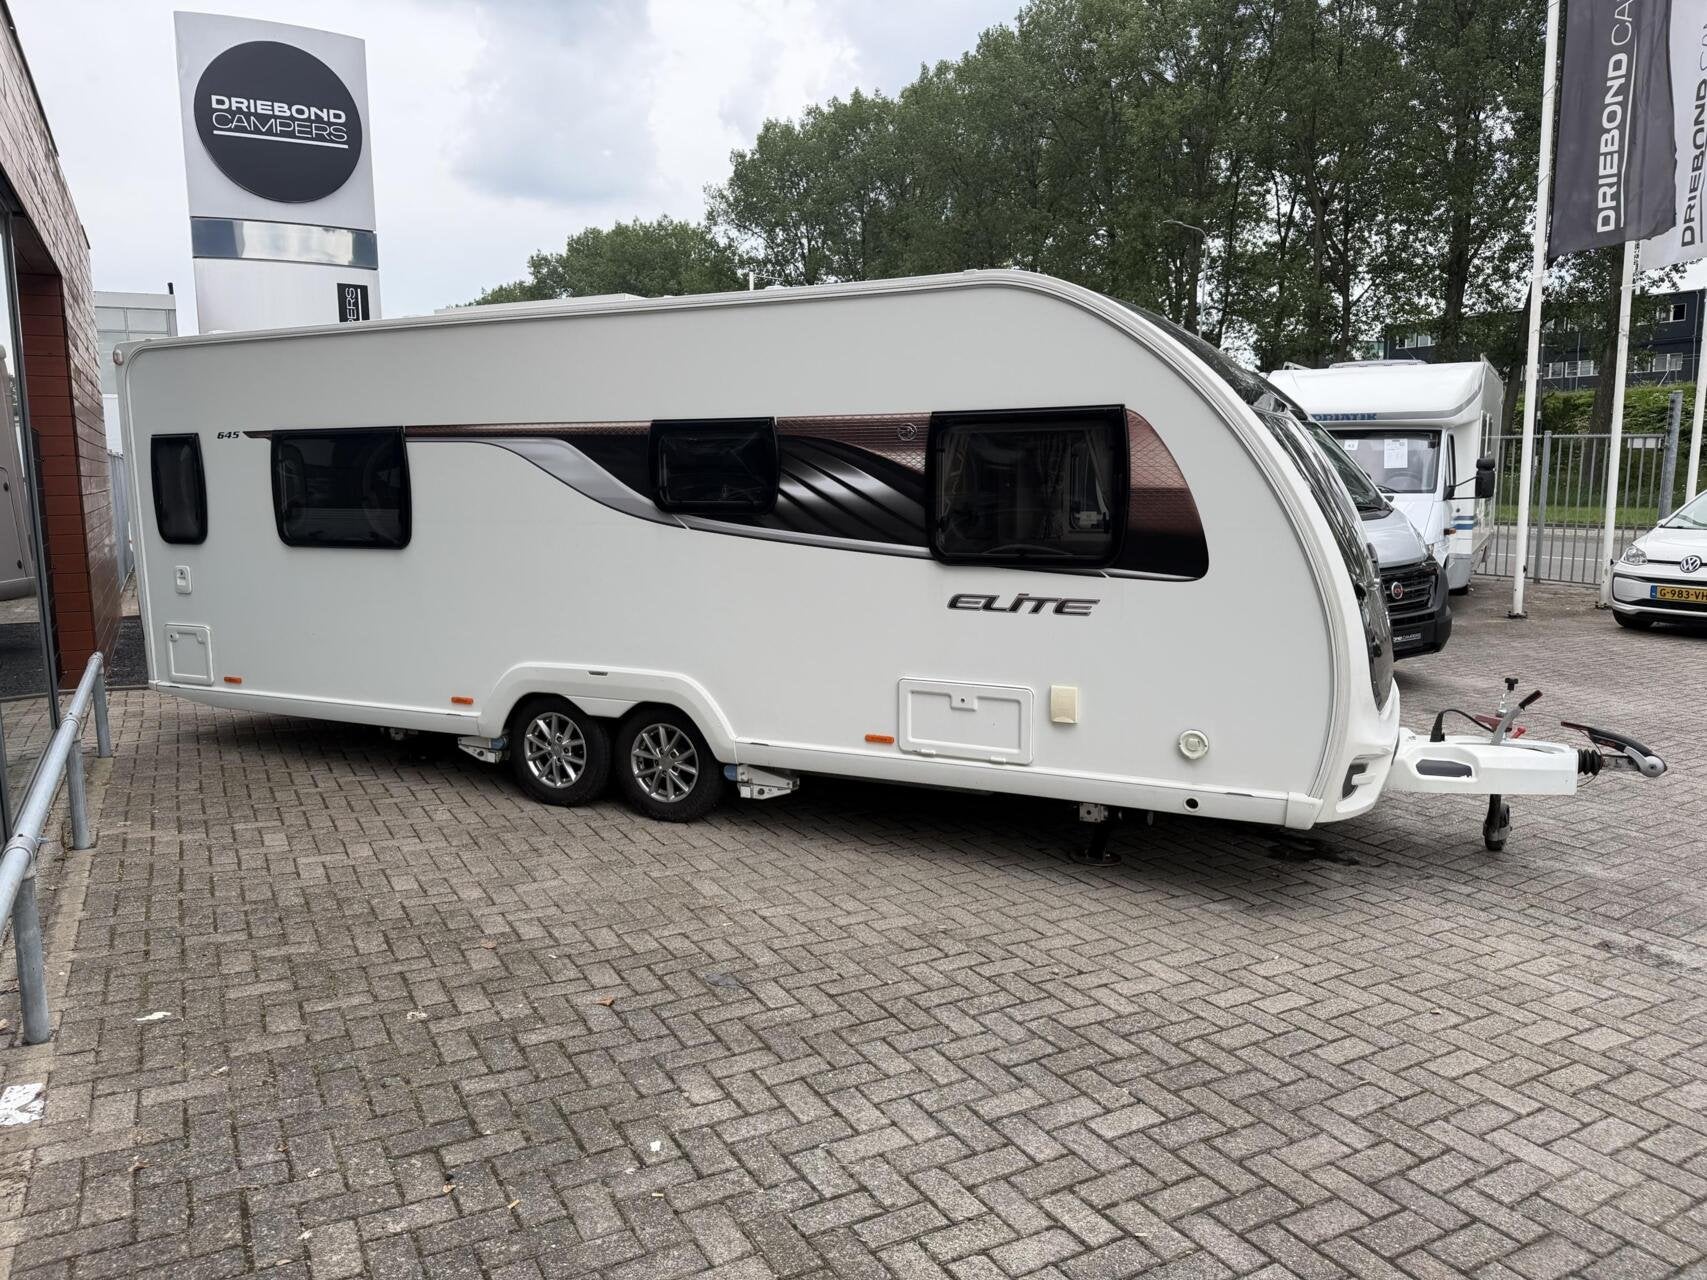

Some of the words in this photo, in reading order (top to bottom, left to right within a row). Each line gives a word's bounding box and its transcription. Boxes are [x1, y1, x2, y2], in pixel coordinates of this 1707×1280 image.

[1611, 0, 1633, 46] CA
[211, 95, 346, 123] DRIEBOND
[212, 112, 348, 142] CAMPERS
[1597, 53, 1628, 232] DRIEBOND
[1681, 79, 1707, 247] DRIEBOND
[217, 431, 240, 440] 645
